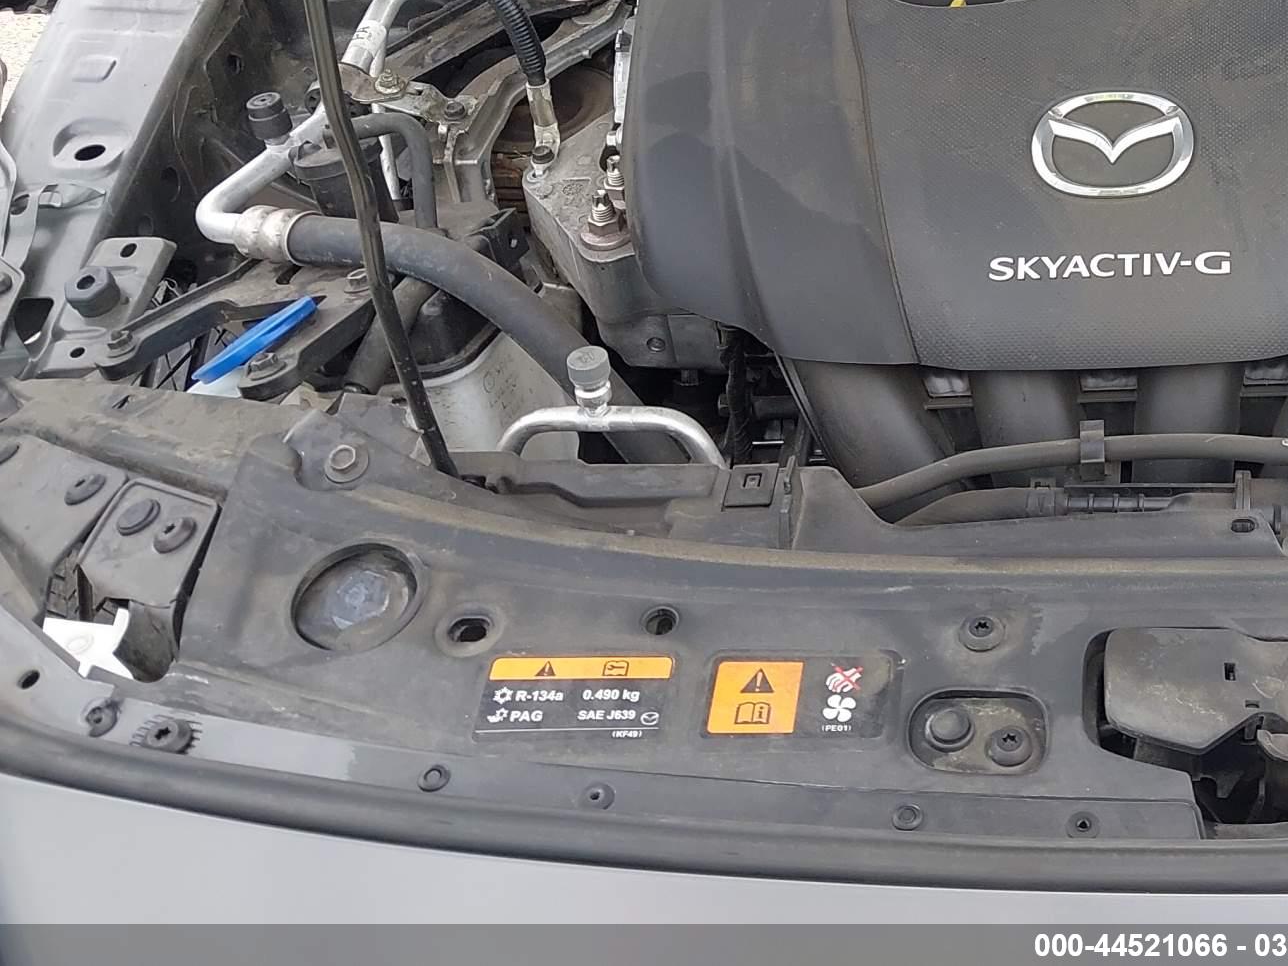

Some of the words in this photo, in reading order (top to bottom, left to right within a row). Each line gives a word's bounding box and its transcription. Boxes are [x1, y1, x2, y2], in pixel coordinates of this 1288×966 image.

[988, 251, 1232, 282] SKYACTIV-G
[515, 690, 564, 701] R-134a
[582, 689, 619, 701] 0.490
[622, 689, 641, 702] kg
[509, 710, 544, 722] PAG
[577, 710, 604, 720] SAE
[606, 709, 637, 720] J639
